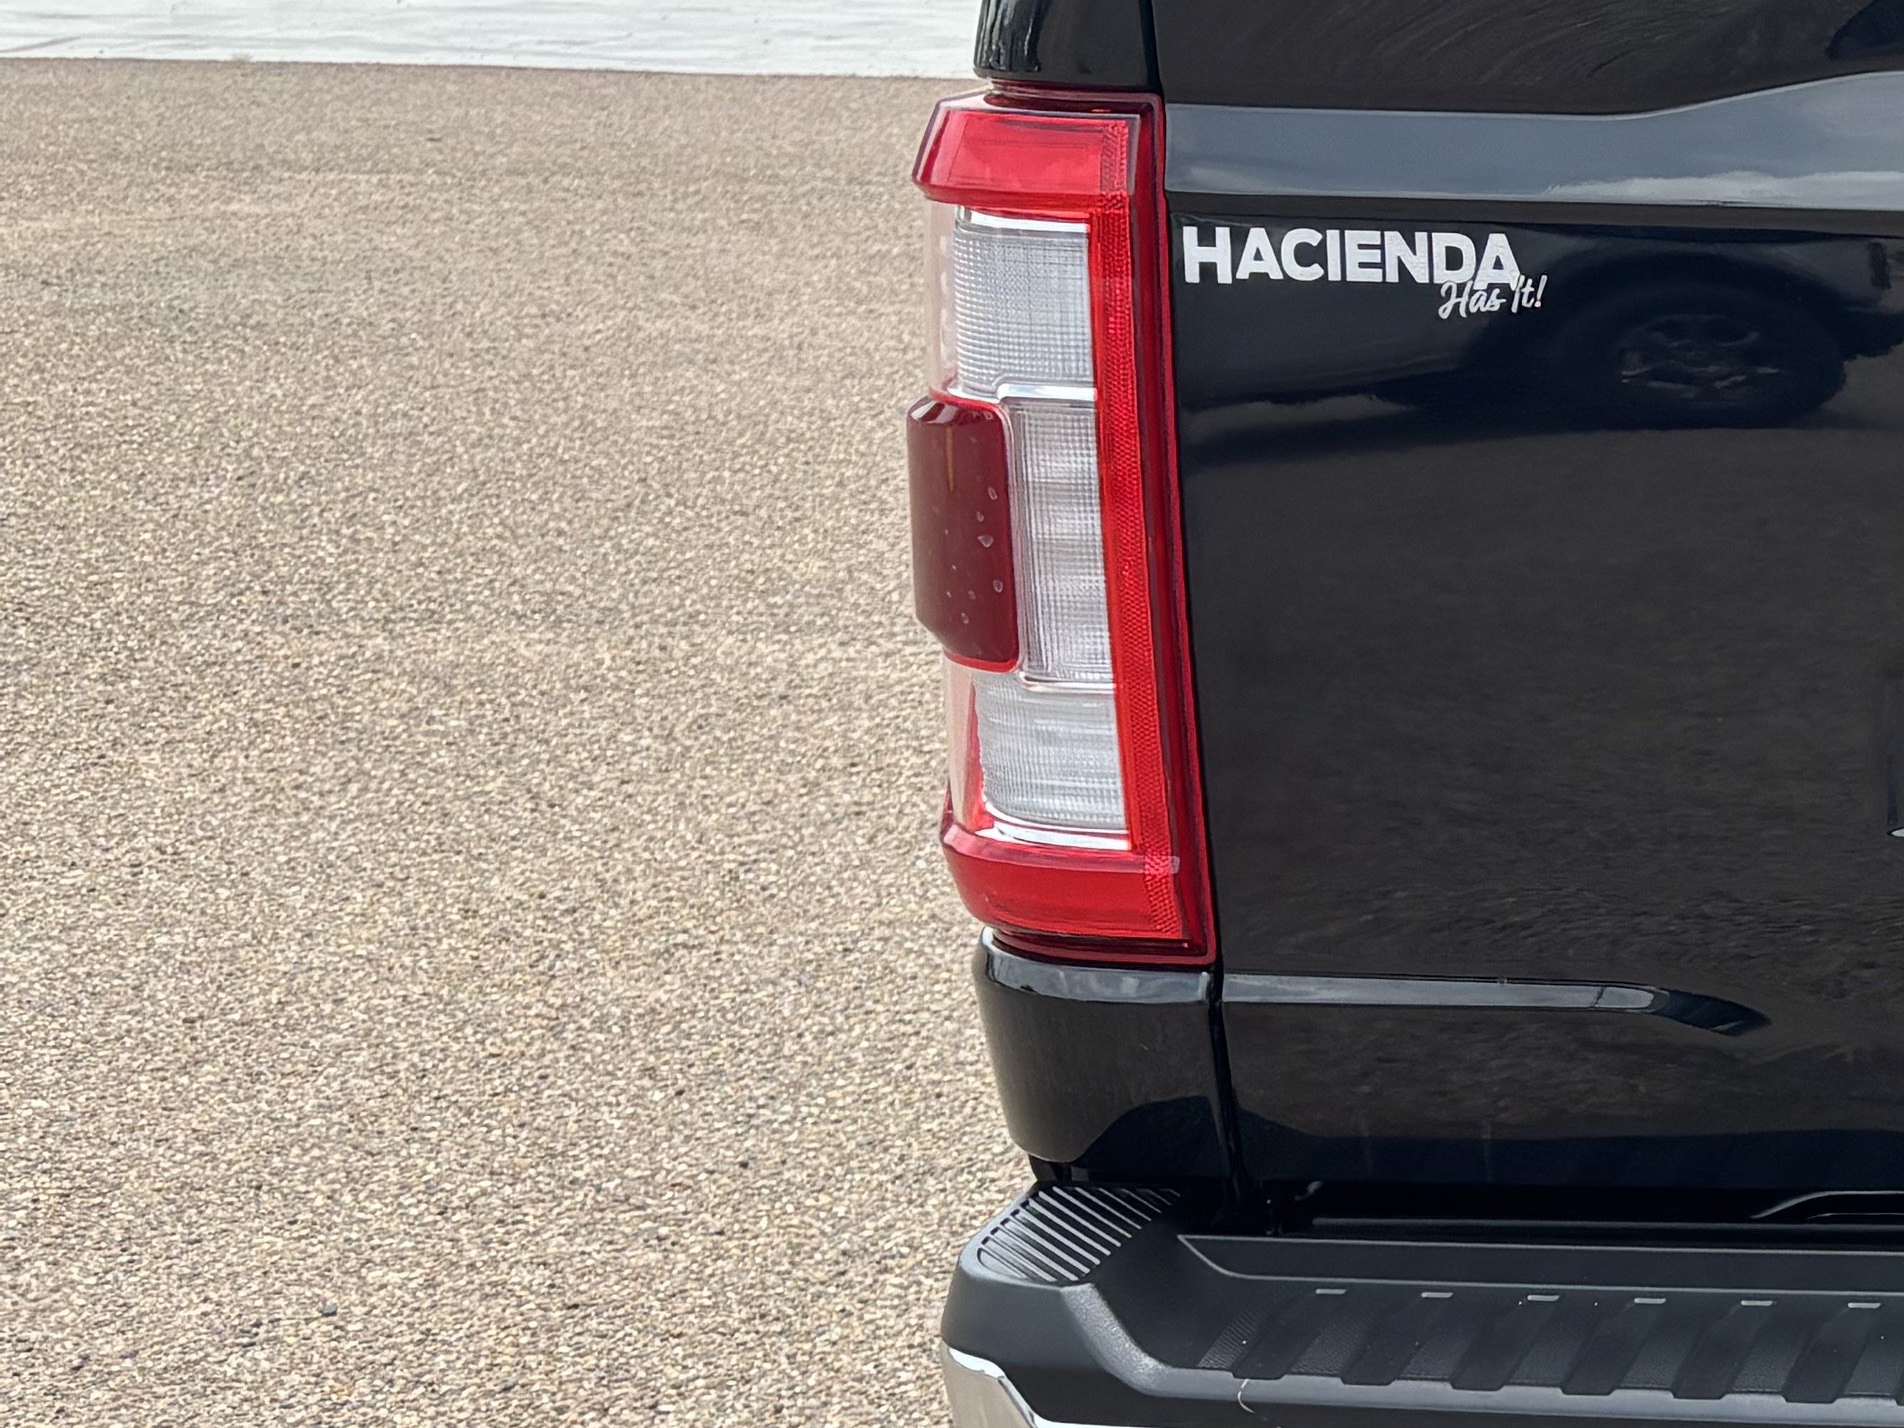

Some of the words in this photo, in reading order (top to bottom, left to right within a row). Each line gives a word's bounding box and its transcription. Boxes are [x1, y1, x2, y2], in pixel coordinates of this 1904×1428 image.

[1182, 225, 1521, 290] HACIENDA
[1437, 278, 1505, 320] Has
[1510, 274, 1548, 314] It!
